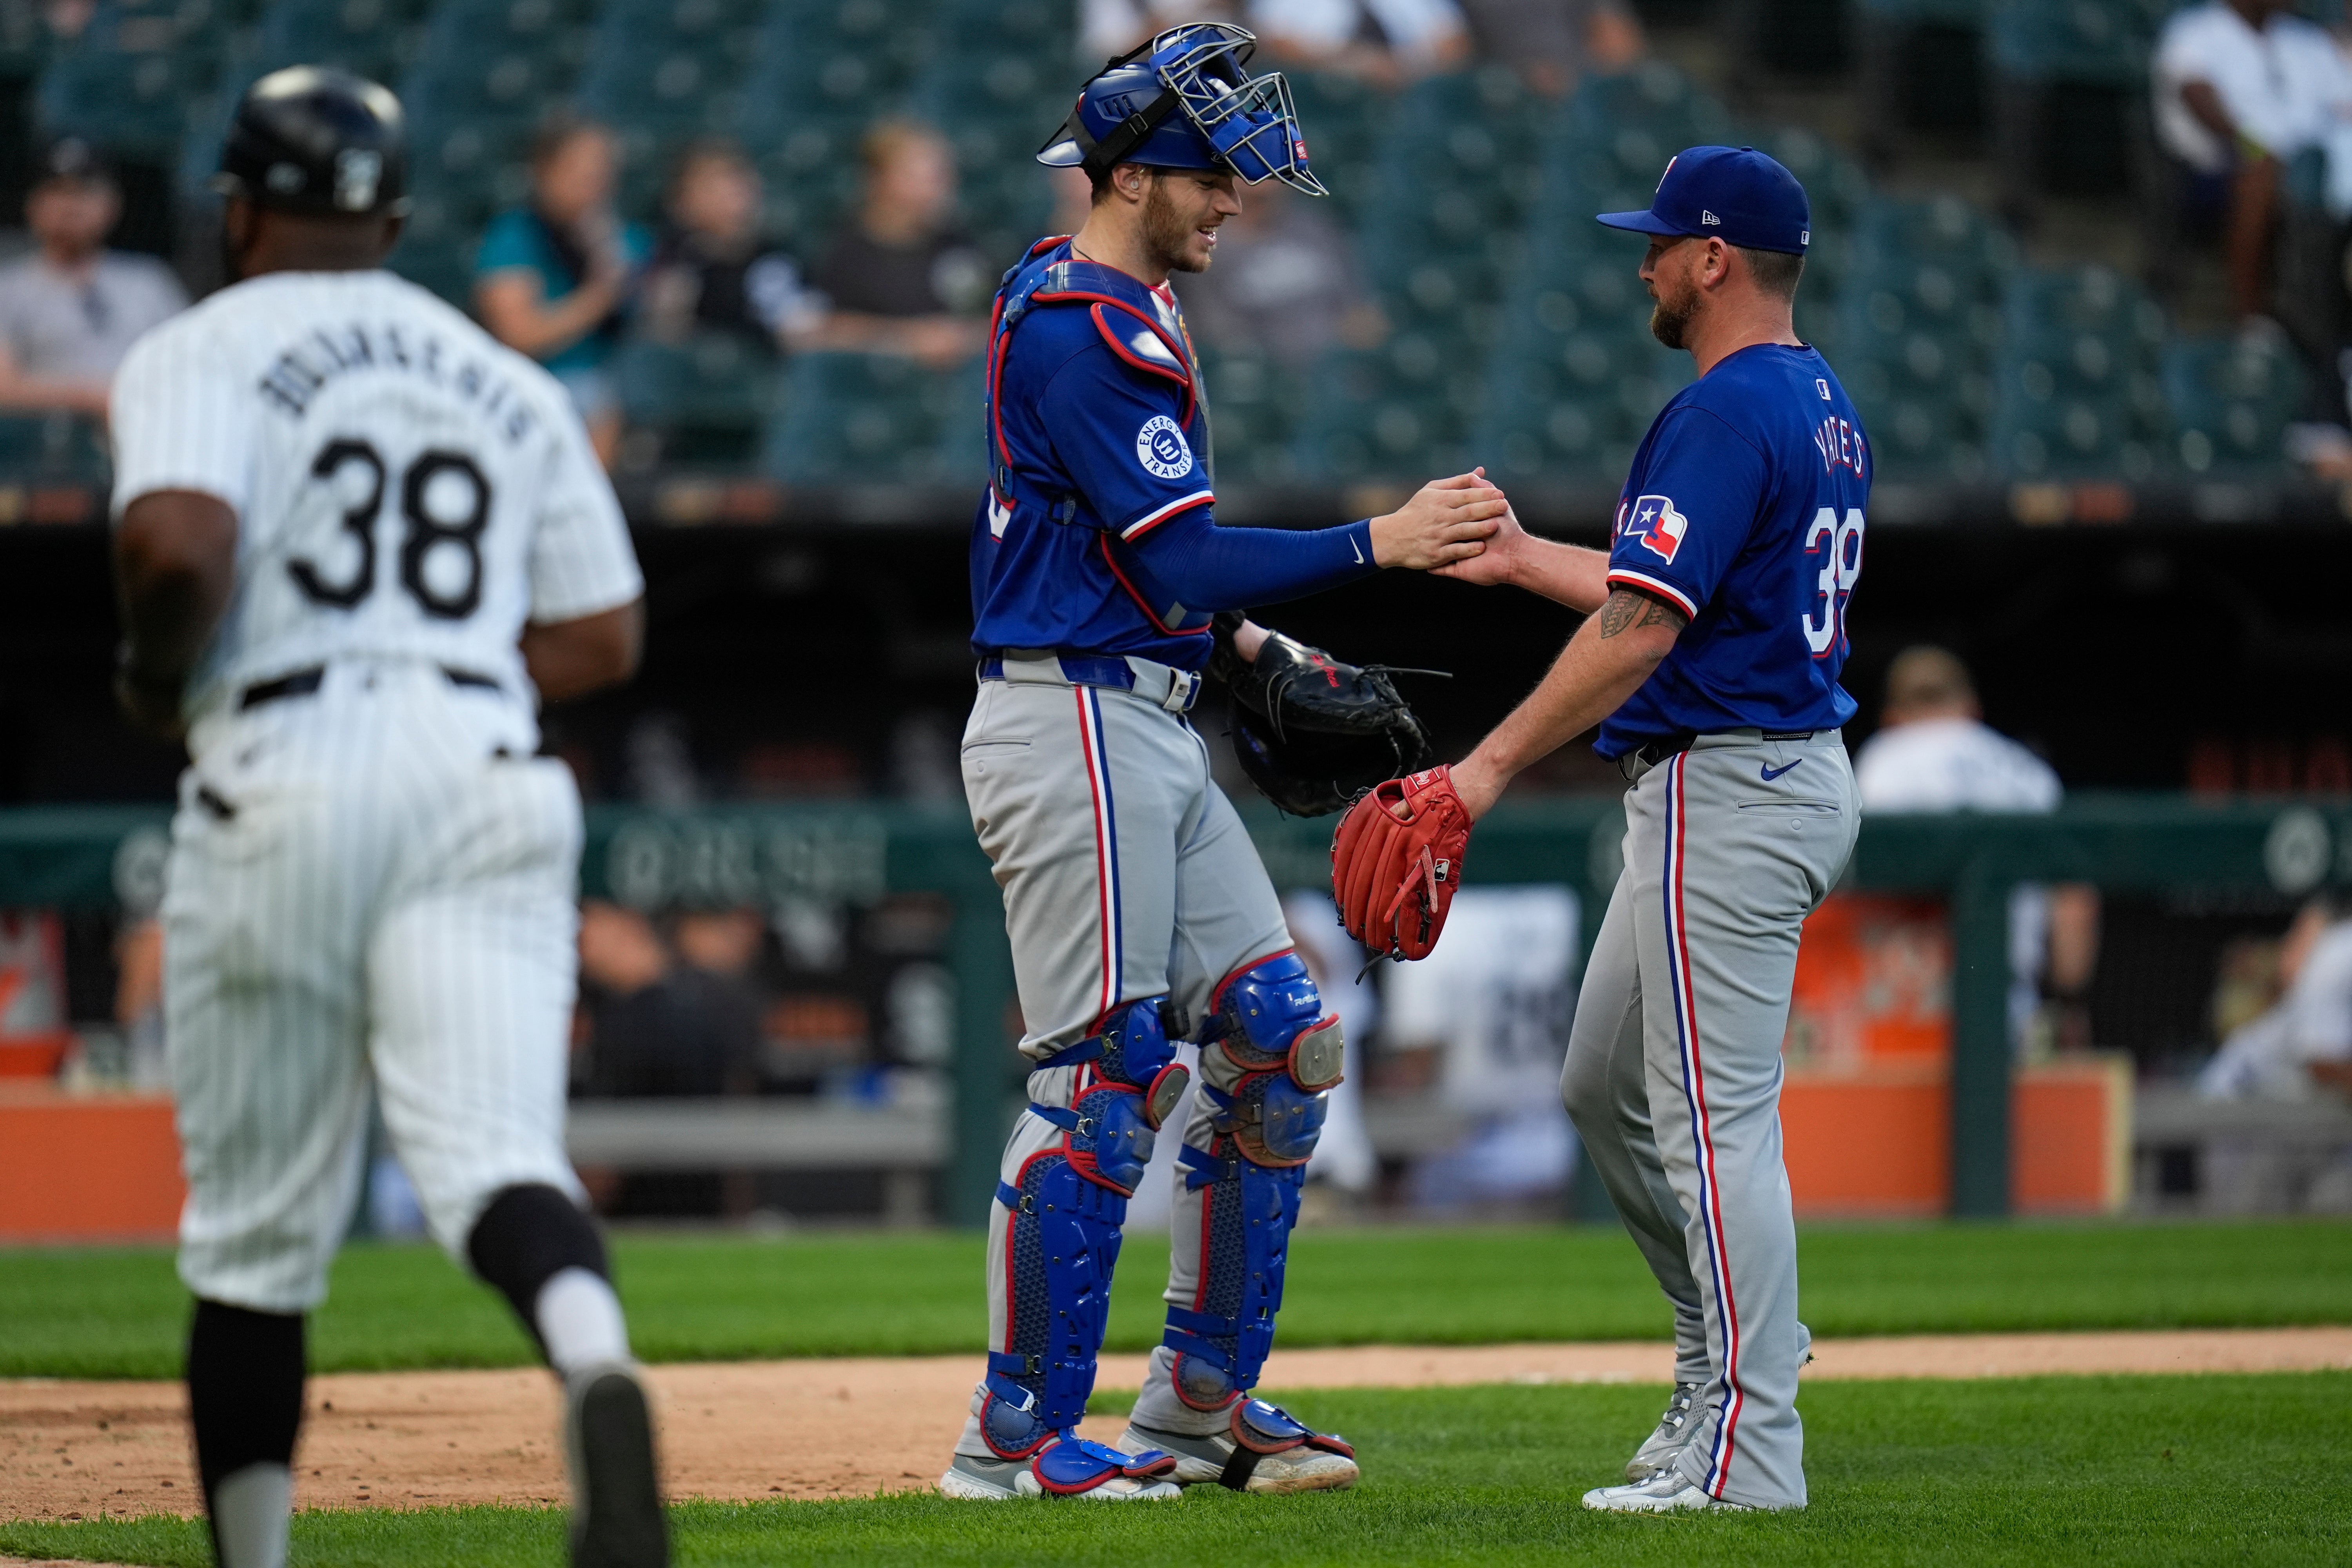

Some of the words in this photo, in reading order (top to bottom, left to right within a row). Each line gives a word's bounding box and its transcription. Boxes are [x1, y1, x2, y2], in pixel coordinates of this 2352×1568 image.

[1139, 417, 1179, 445] ENERGY
[1145, 444, 1191, 477] TRANSFER
[1815, 417, 1864, 476] YATES
[287, 436, 492, 620] 38
[1802, 507, 1866, 655] 39
